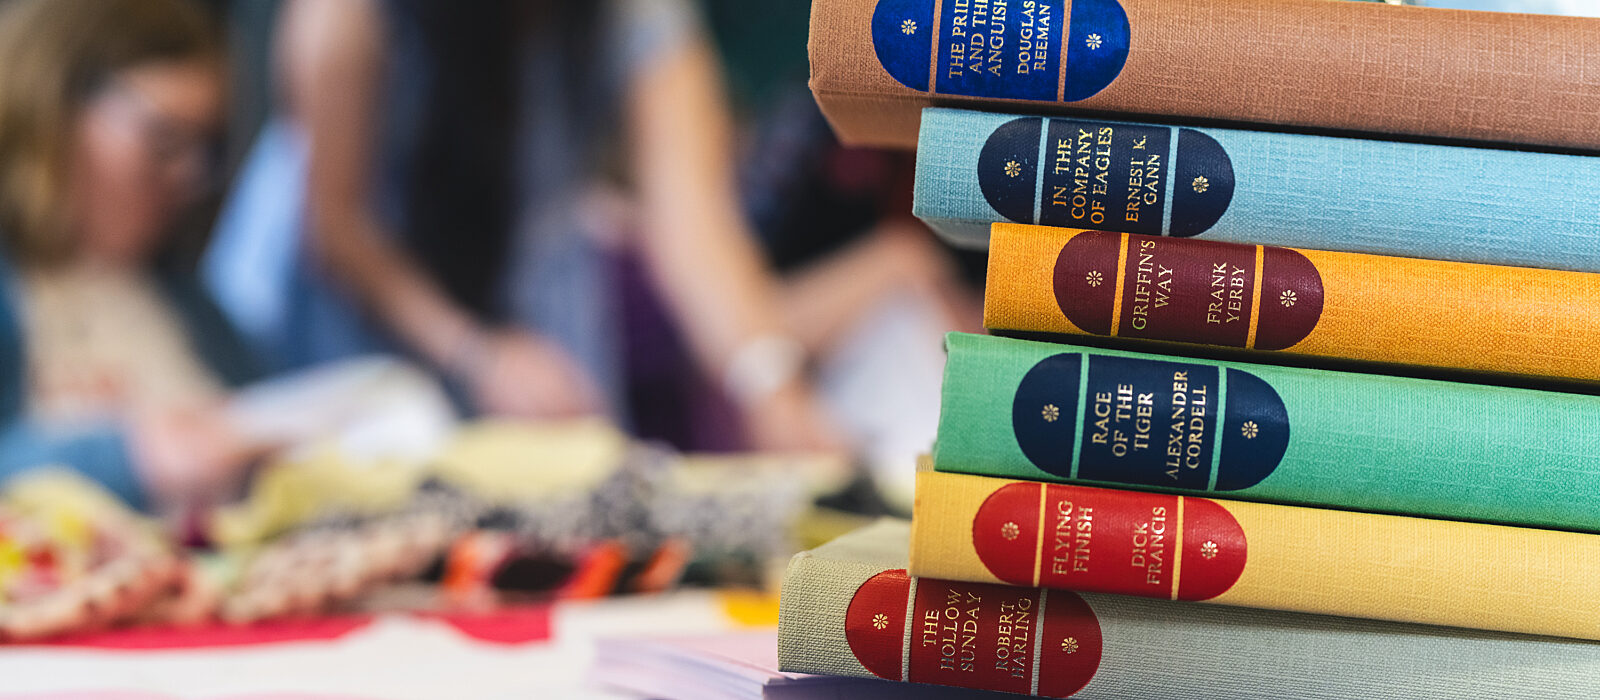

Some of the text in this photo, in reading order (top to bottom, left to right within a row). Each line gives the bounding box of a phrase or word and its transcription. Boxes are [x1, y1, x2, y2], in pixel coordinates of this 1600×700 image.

[949, 43, 965, 79] THE
[969, 33, 985, 74] AND
[1017, 0, 1036, 75] DOUGLAS
[1034, 4, 1051, 71] REEMAN
[1053, 138, 1072, 207] IN THE
[1071, 128, 1093, 219] COMPANY
[1090, 127, 1113, 224] OF EAGLES
[1125, 135, 1147, 222] ERNEST K.
[1143, 154, 1160, 205] GANN
[1132, 240, 1156, 330] GRIFFIN'S
[1154, 264, 1173, 308] WAY
[1207, 262, 1227, 324] FRANK
[1226, 265, 1245, 323] YERBY
[1092, 392, 1112, 444] RACE
[1112, 383, 1133, 457] OF THE
[1133, 392, 1154, 452] TIGER
[1165, 369, 1188, 480] ALEXANDER
[1186, 385, 1206, 469] CORDELL
[1052, 500, 1073, 575] FLYING
[1073, 505, 1093, 572] FINISH
[1131, 522, 1148, 568] DICK
[1147, 506, 1166, 584] FRANCIS
[922, 609, 940, 647] THE
[940, 588, 961, 671] HOLLOW
[960, 591, 981, 672] SUNDAY
[995, 600, 1015, 671] ROBERT
[1011, 598, 1032, 679] HARLING
